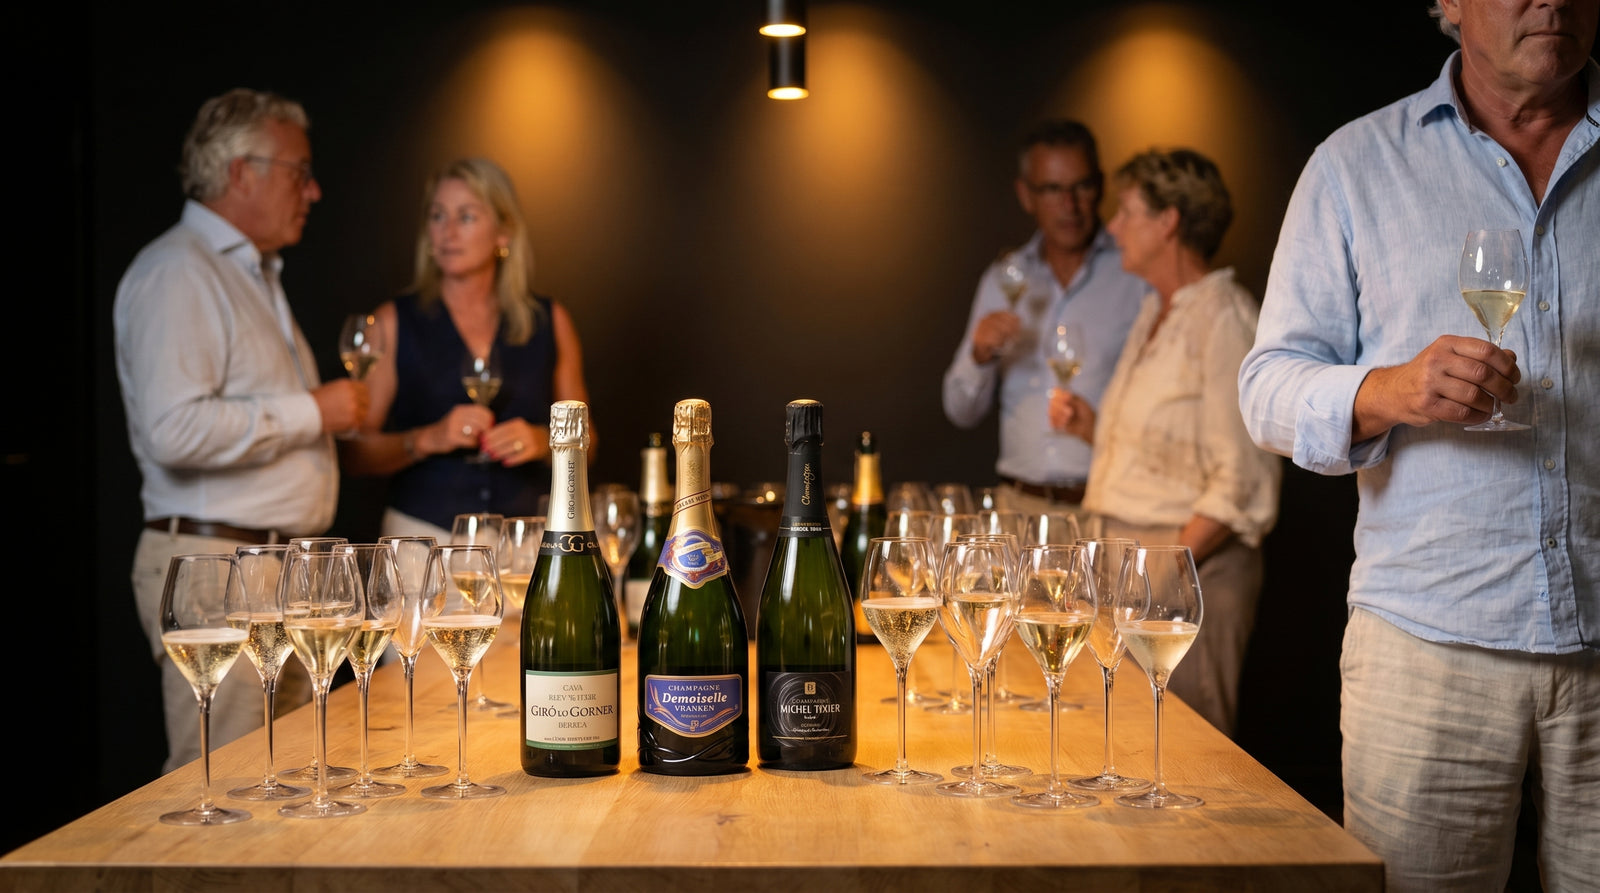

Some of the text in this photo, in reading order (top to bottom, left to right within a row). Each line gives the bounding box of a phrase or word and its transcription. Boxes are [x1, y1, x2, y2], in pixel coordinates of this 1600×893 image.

[662, 692, 728, 704] Demoiselle
[531, 705, 557, 717] GIRÓ
[569, 704, 614, 717] GORNER
[780, 703, 841, 714] MICHEL TIXIER
